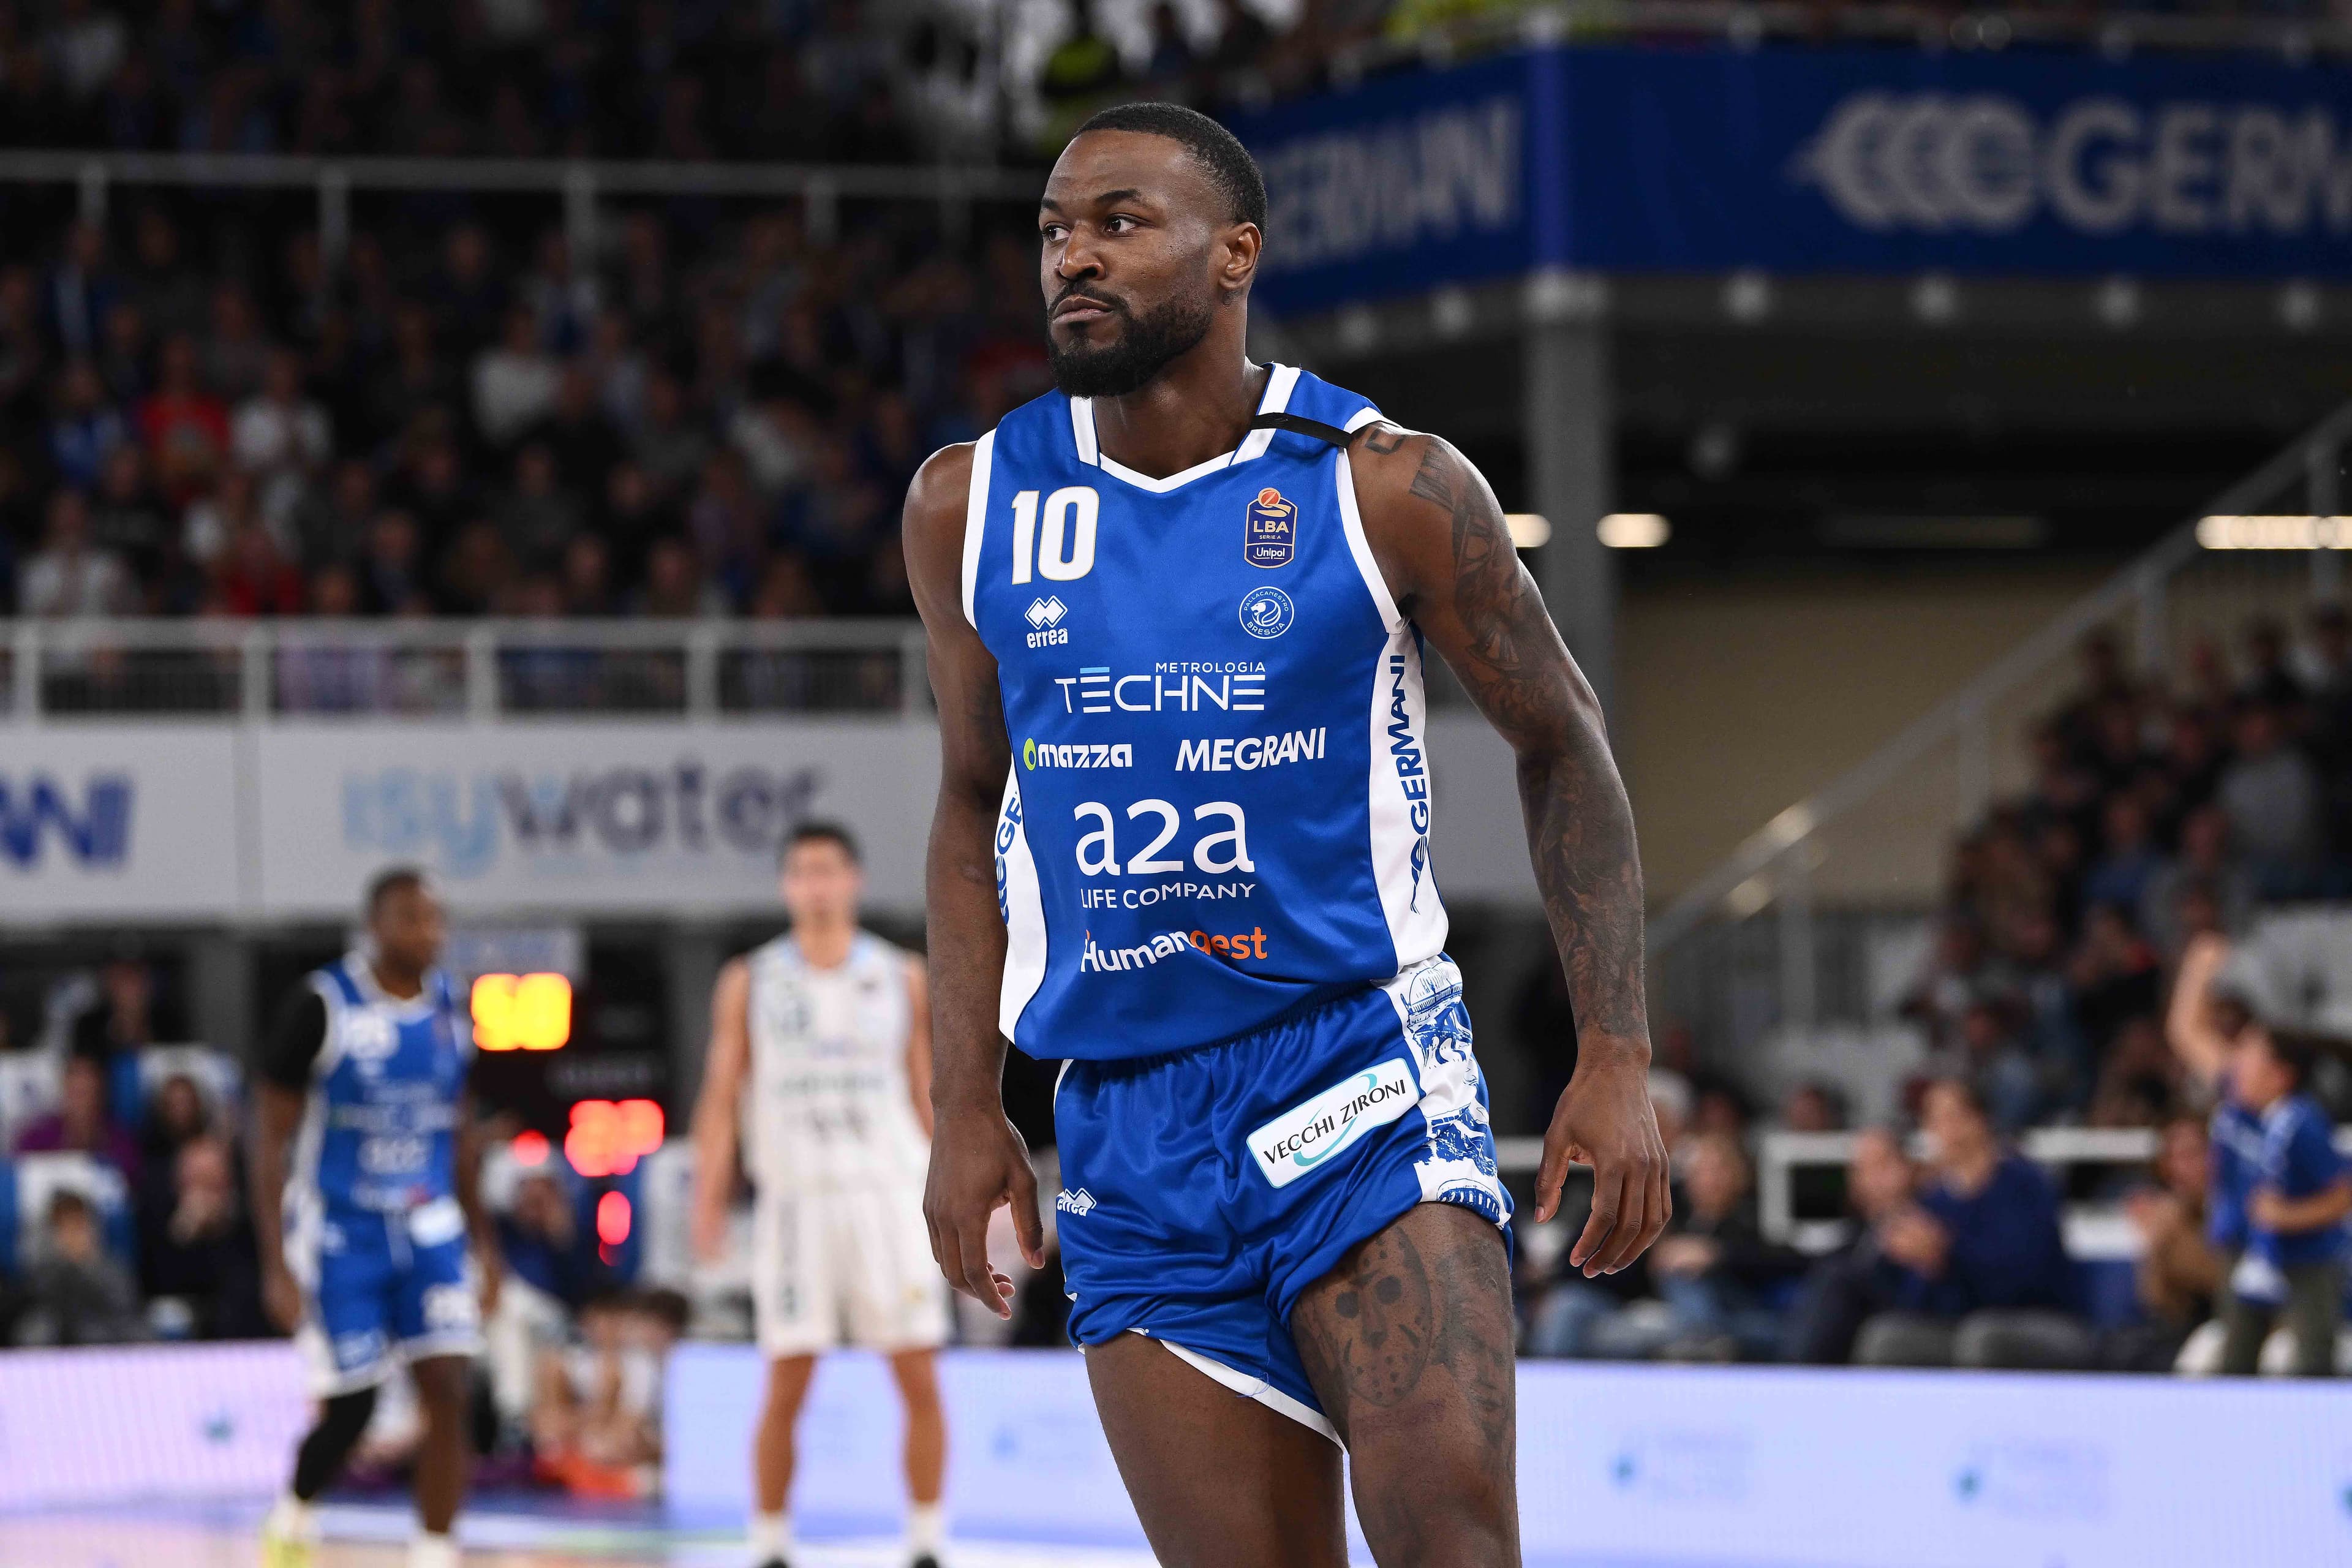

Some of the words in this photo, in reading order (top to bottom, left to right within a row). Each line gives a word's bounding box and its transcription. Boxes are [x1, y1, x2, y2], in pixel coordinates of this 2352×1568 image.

[1011, 486, 1100, 585] 10
[1253, 521, 1289, 533] LBA
[1256, 547, 1285, 560] Unipol
[1243, 591, 1289, 611] PALLACANESTRO
[1246, 621, 1285, 635] BRESCIA
[1156, 662, 1266, 673] METROLOGIA
[1055, 667, 1265, 714] TECHNE
[1175, 727, 1326, 772] MEGRANI
[1387, 655, 1429, 835] GERMANI
[1074, 799, 1255, 876] a2a
[1081, 888, 1118, 909] LIFE
[1123, 883, 1256, 909] COMPANY
[1080, 925, 1267, 973] Humangest
[1263, 1114, 1335, 1164] VECCHI
[1340, 1079, 1406, 1125] ZIRONI
